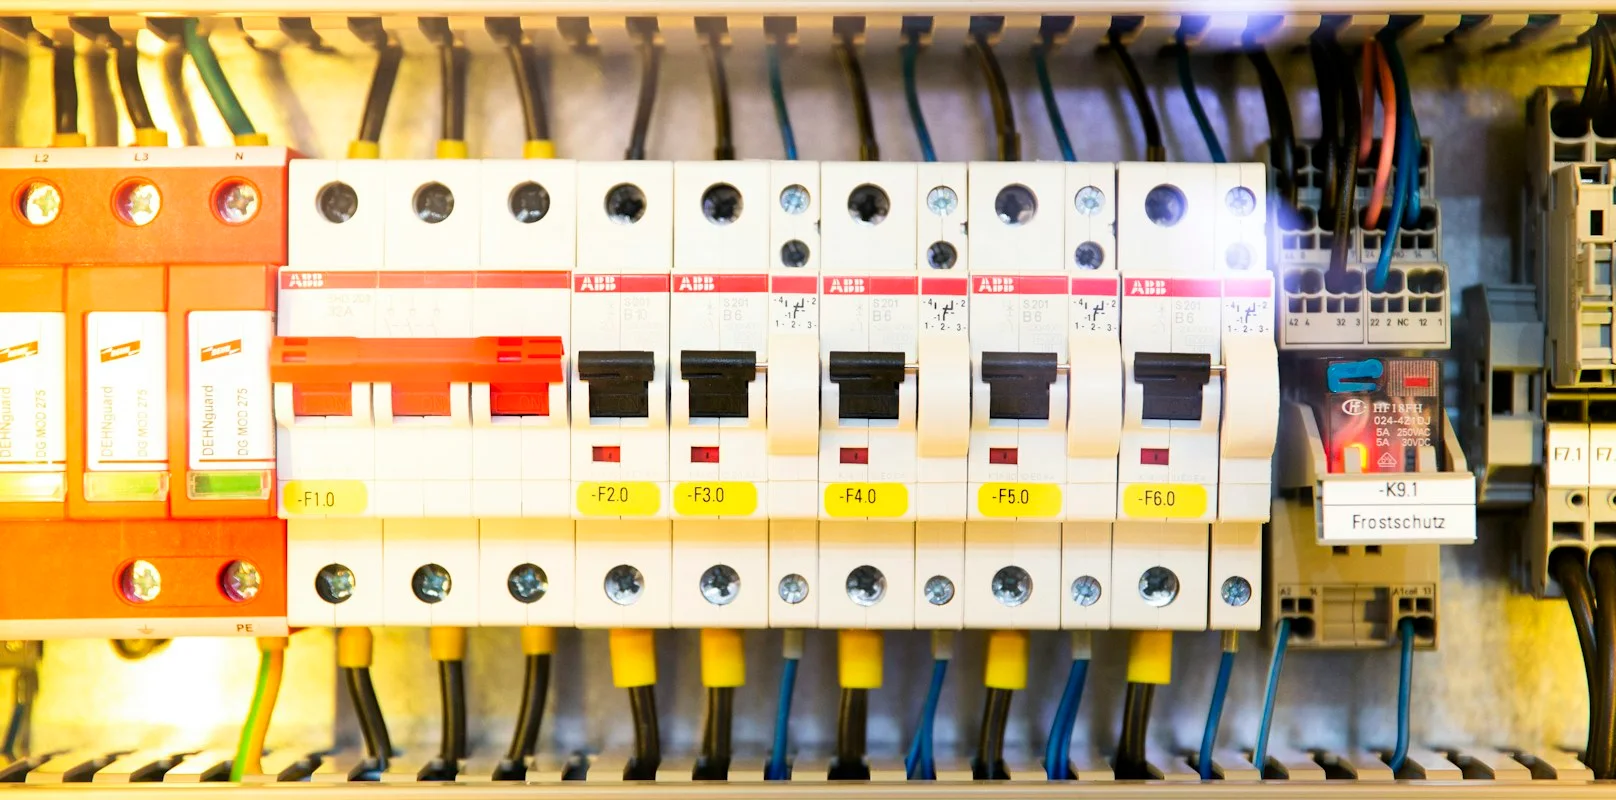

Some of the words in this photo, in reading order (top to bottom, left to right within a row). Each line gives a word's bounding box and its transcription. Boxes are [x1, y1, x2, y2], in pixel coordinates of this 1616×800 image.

[34, 154, 49, 163] L2
[134, 152, 149, 162] L3
[235, 152, 244, 161] N
[289, 273, 324, 287] ABB
[580, 276, 616, 291] ABB
[679, 276, 715, 291] ABB
[830, 278, 865, 292] ABB
[978, 277, 1014, 292] ABB
[1130, 280, 1166, 295] ABB
[1289, 318, 1299, 326] 42
[1305, 318, 1310, 326] 4
[1336, 318, 1346, 326] 32
[1356, 318, 1360, 326] 3
[1370, 318, 1380, 326] 22
[1387, 318, 1391, 326] 2
[1397, 318, 1409, 326] NC
[1419, 318, 1427, 326] 12
[1438, 318, 1442, 326] 1
[35, 390, 46, 408] 275
[136, 389, 148, 408] 275
[237, 388, 248, 406] 275
[1373, 404, 1422, 413] HF18FH
[35, 411, 46, 438] MOD
[100, 386, 115, 457] DEHNguard
[136, 411, 148, 438] MOD
[202, 385, 216, 456] DEHNguard
[237, 409, 248, 436] MOD
[1376, 428, 1390, 436] 5A
[1396, 428, 1431, 436] 250VAC
[136, 441, 148, 457] DG
[237, 440, 248, 456] DG
[1376, 438, 1390, 446] 5A
[1402, 438, 1431, 446] 30VDC
[35, 442, 46, 458] DG
[1554, 448, 1580, 461] F7.1
[591, 487, 628, 502] -F2.0
[688, 487, 724, 502] -F3.0
[839, 488, 876, 504] -F4.0
[992, 489, 1029, 504] -F5.0
[1379, 482, 1417, 497] -K9.1
[298, 492, 334, 506] -F1.0
[1138, 490, 1175, 506] -F6.0
[1353, 514, 1446, 529] Frostschutz
[237, 624, 253, 632] PE
